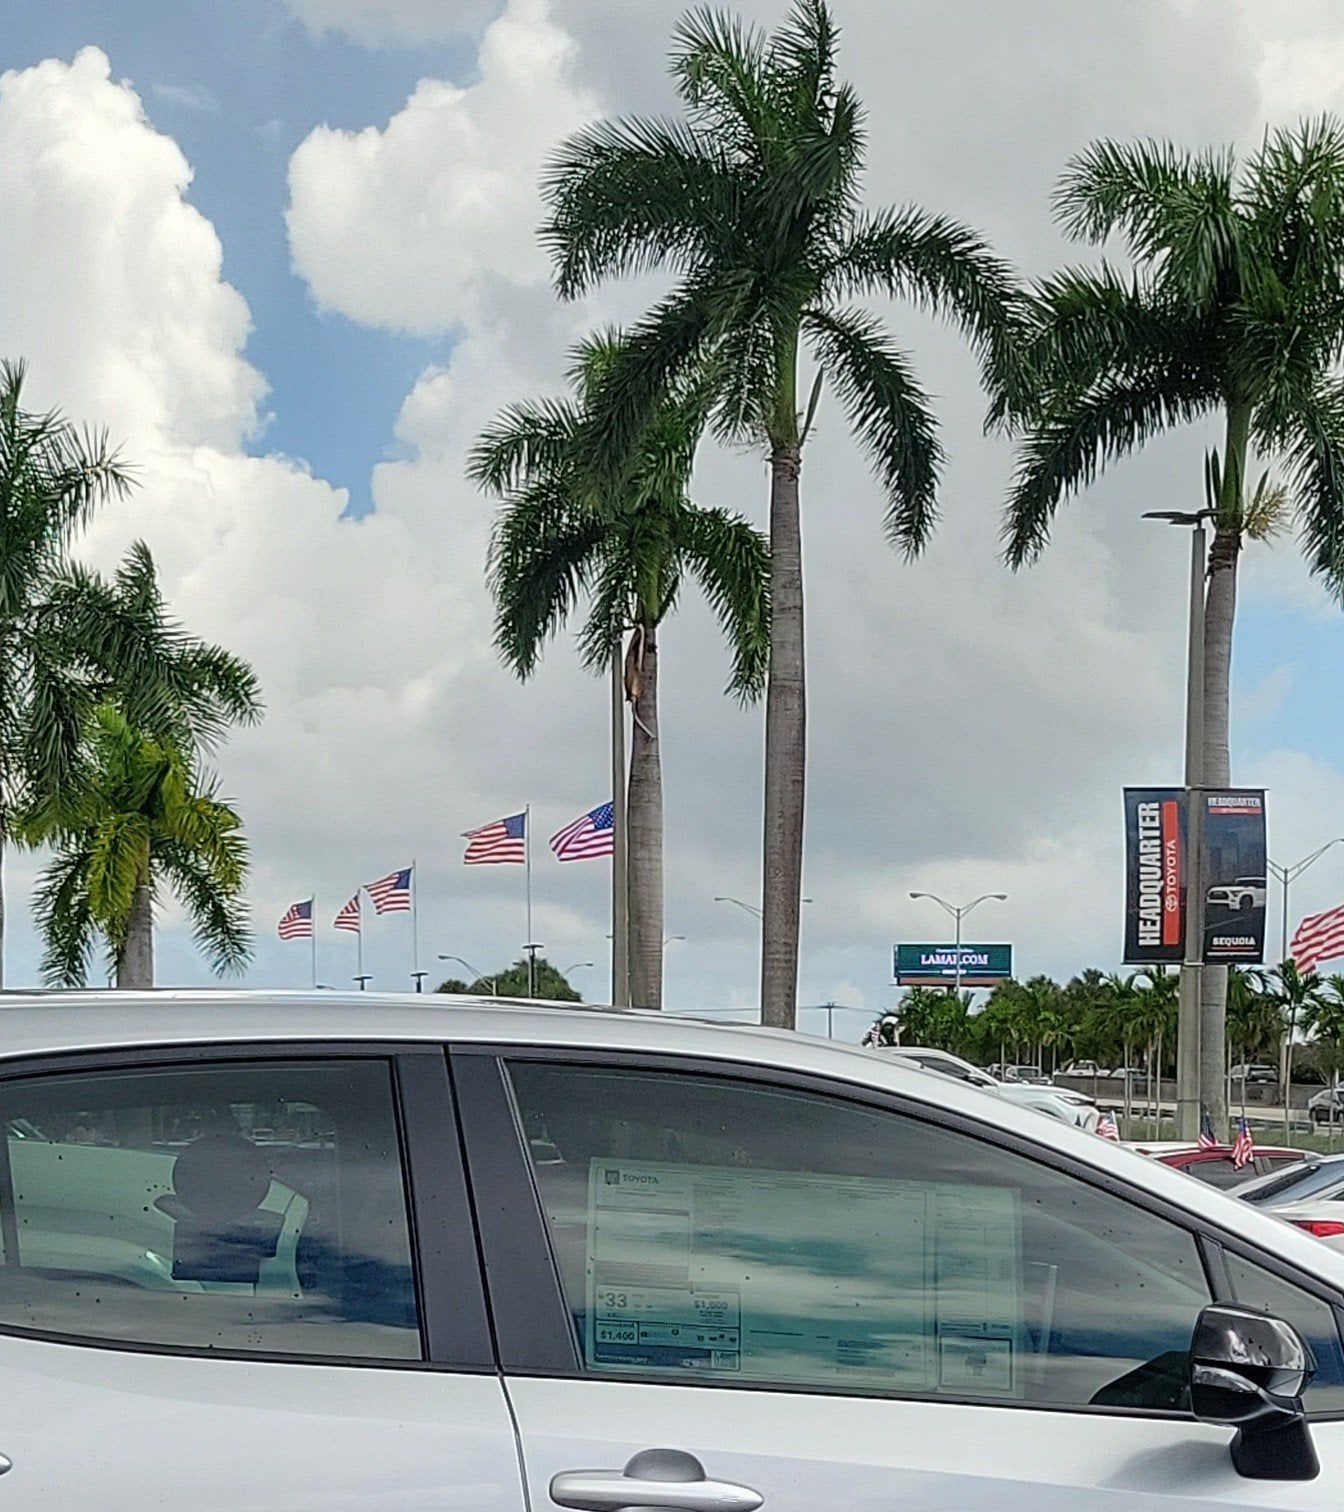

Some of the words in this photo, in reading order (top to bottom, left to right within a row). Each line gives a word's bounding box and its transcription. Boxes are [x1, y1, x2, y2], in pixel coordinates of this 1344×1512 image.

[1138, 802, 1164, 946] HEADQUARTER
[1165, 839, 1177, 894] TOYOTA
[1212, 936, 1256, 947] SEQUOIA
[622, 1174, 659, 1185] TOYOTA
[606, 1292, 628, 1308] 33
